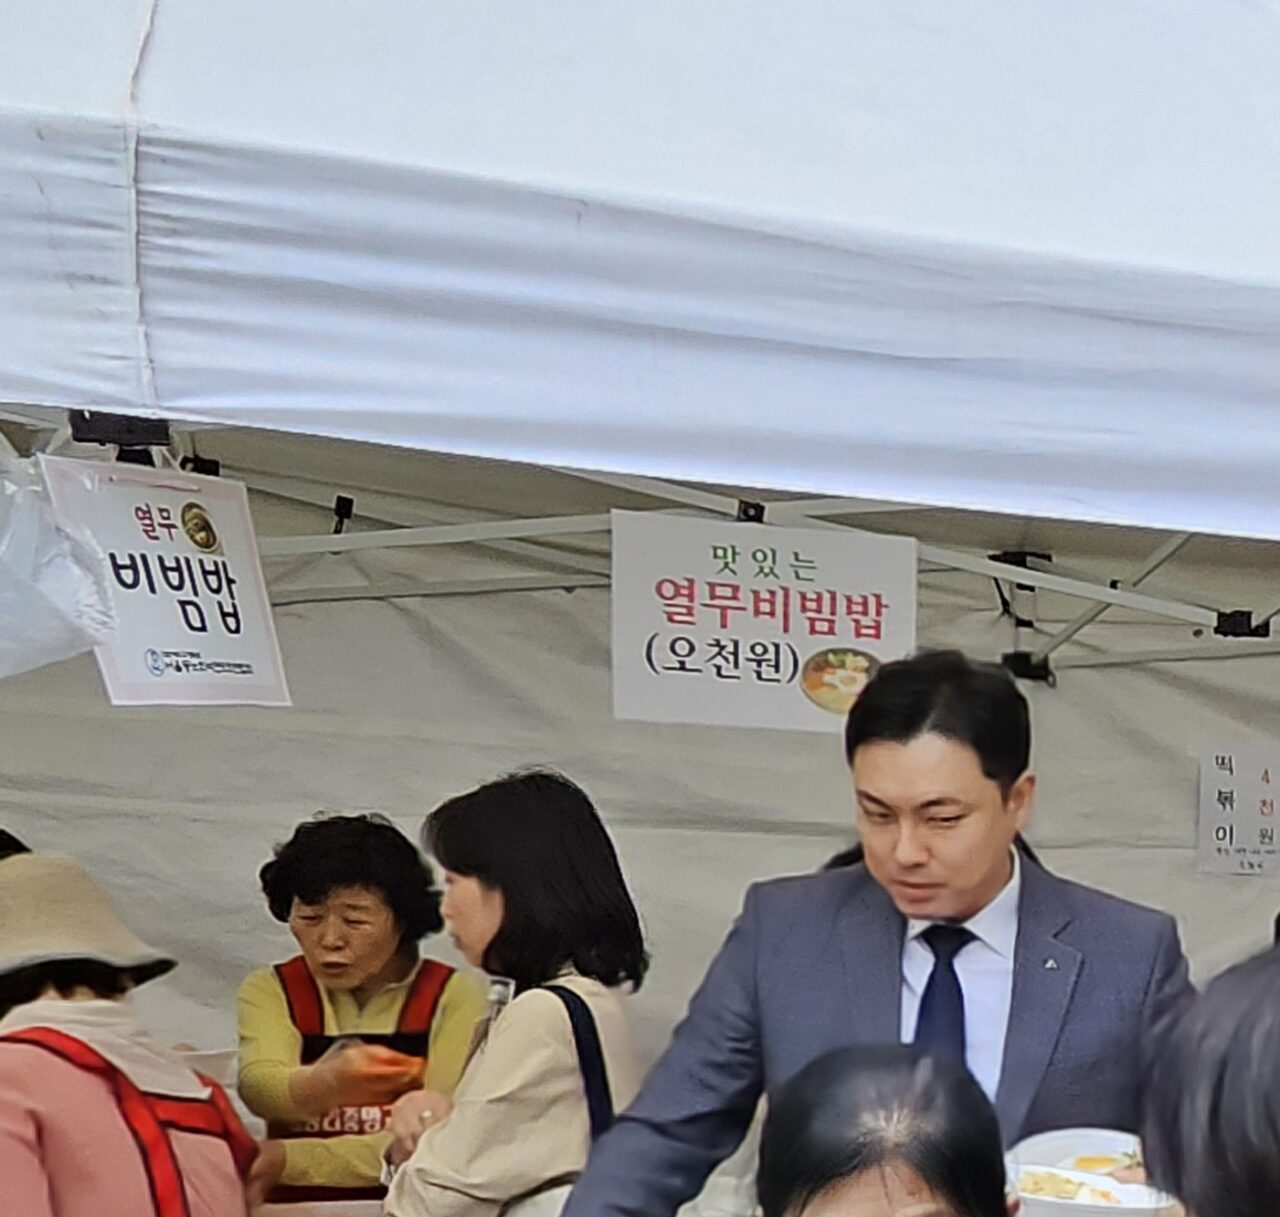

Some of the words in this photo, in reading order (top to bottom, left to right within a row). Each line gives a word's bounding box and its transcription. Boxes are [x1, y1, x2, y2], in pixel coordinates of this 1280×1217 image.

[135, 502, 179, 542] 열무
[711, 544, 818, 582] 맛있는
[108, 551, 241, 635] 비빔밥
[655, 576, 889, 640] 열무비빔밥
[645, 632, 799, 685] (오천원)
